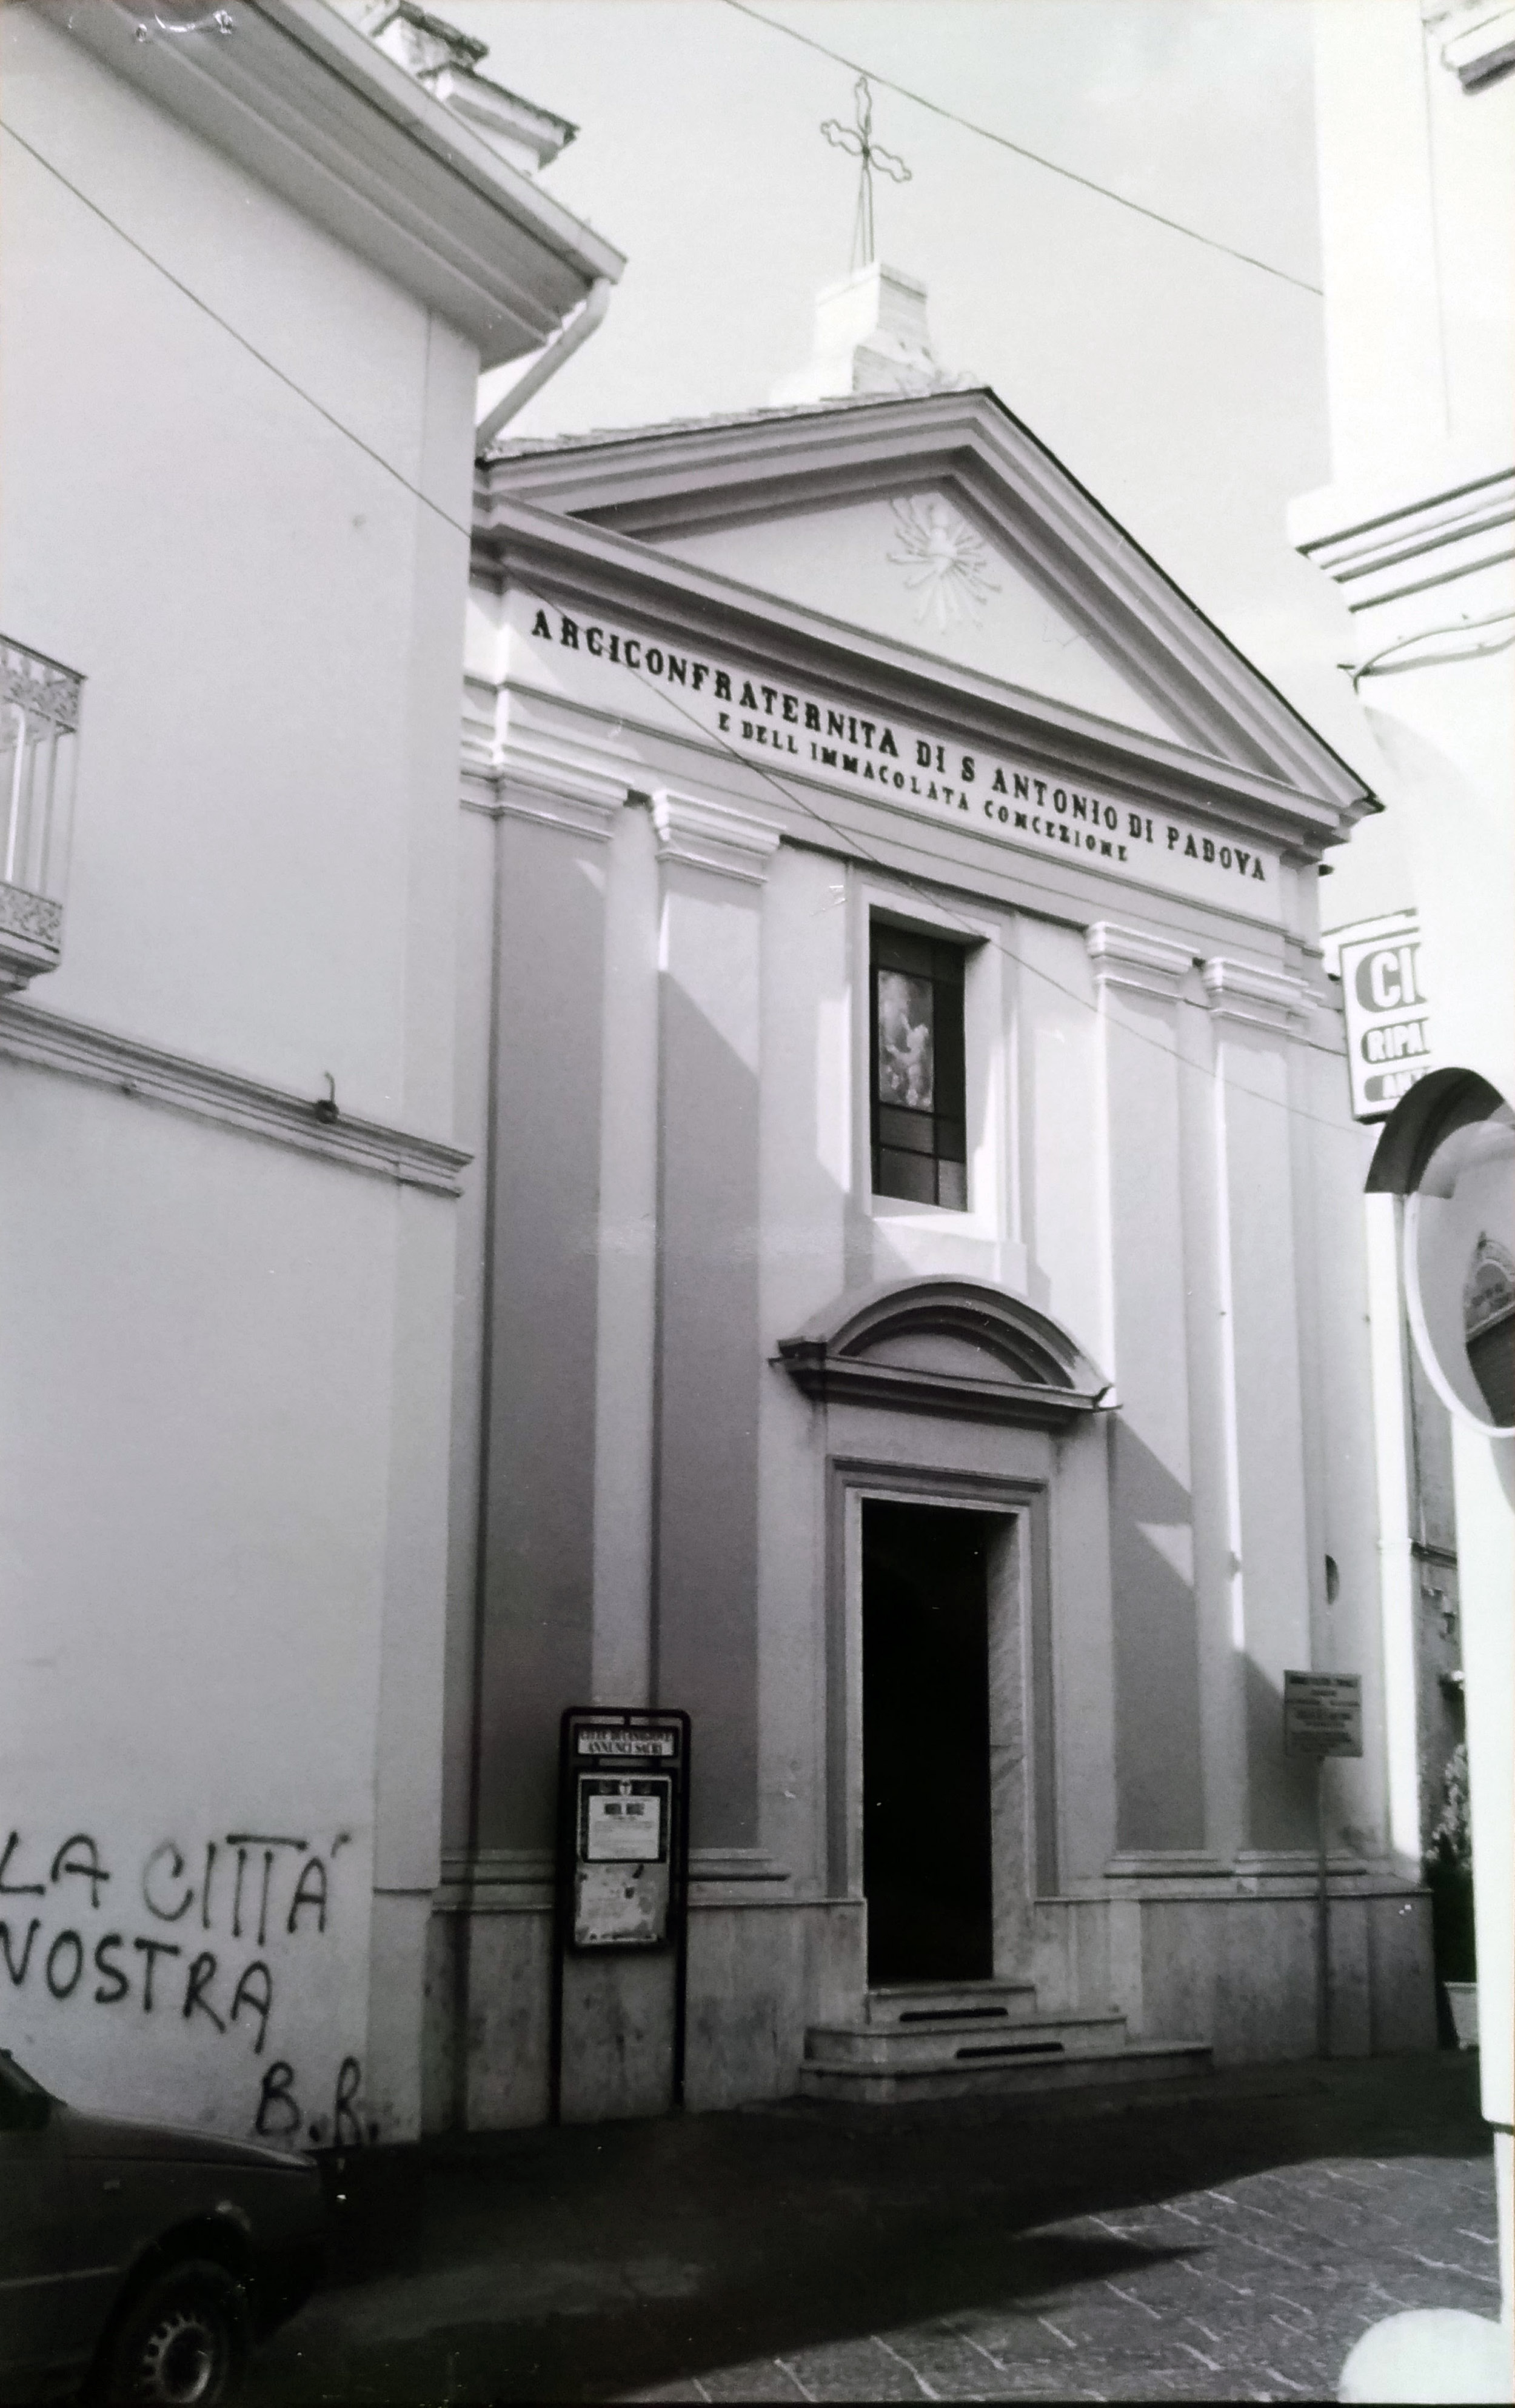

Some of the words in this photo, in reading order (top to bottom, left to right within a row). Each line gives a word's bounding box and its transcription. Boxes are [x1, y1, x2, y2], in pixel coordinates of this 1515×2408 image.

[718, 711, 731, 732] E
[741, 720, 798, 754] DELL
[811, 741, 968, 810] IMMACOLATA
[984, 799, 1128, 861] CONCEZIONE
[916, 739, 945, 773] DI
[991, 767, 1117, 830] ANTONIO
[1128, 812, 1154, 844] DI
[1165, 825, 1266, 881] PADOVA
[0, 1830, 110, 1909] LA
[0, 1918, 273, 2055] VOSTRA
